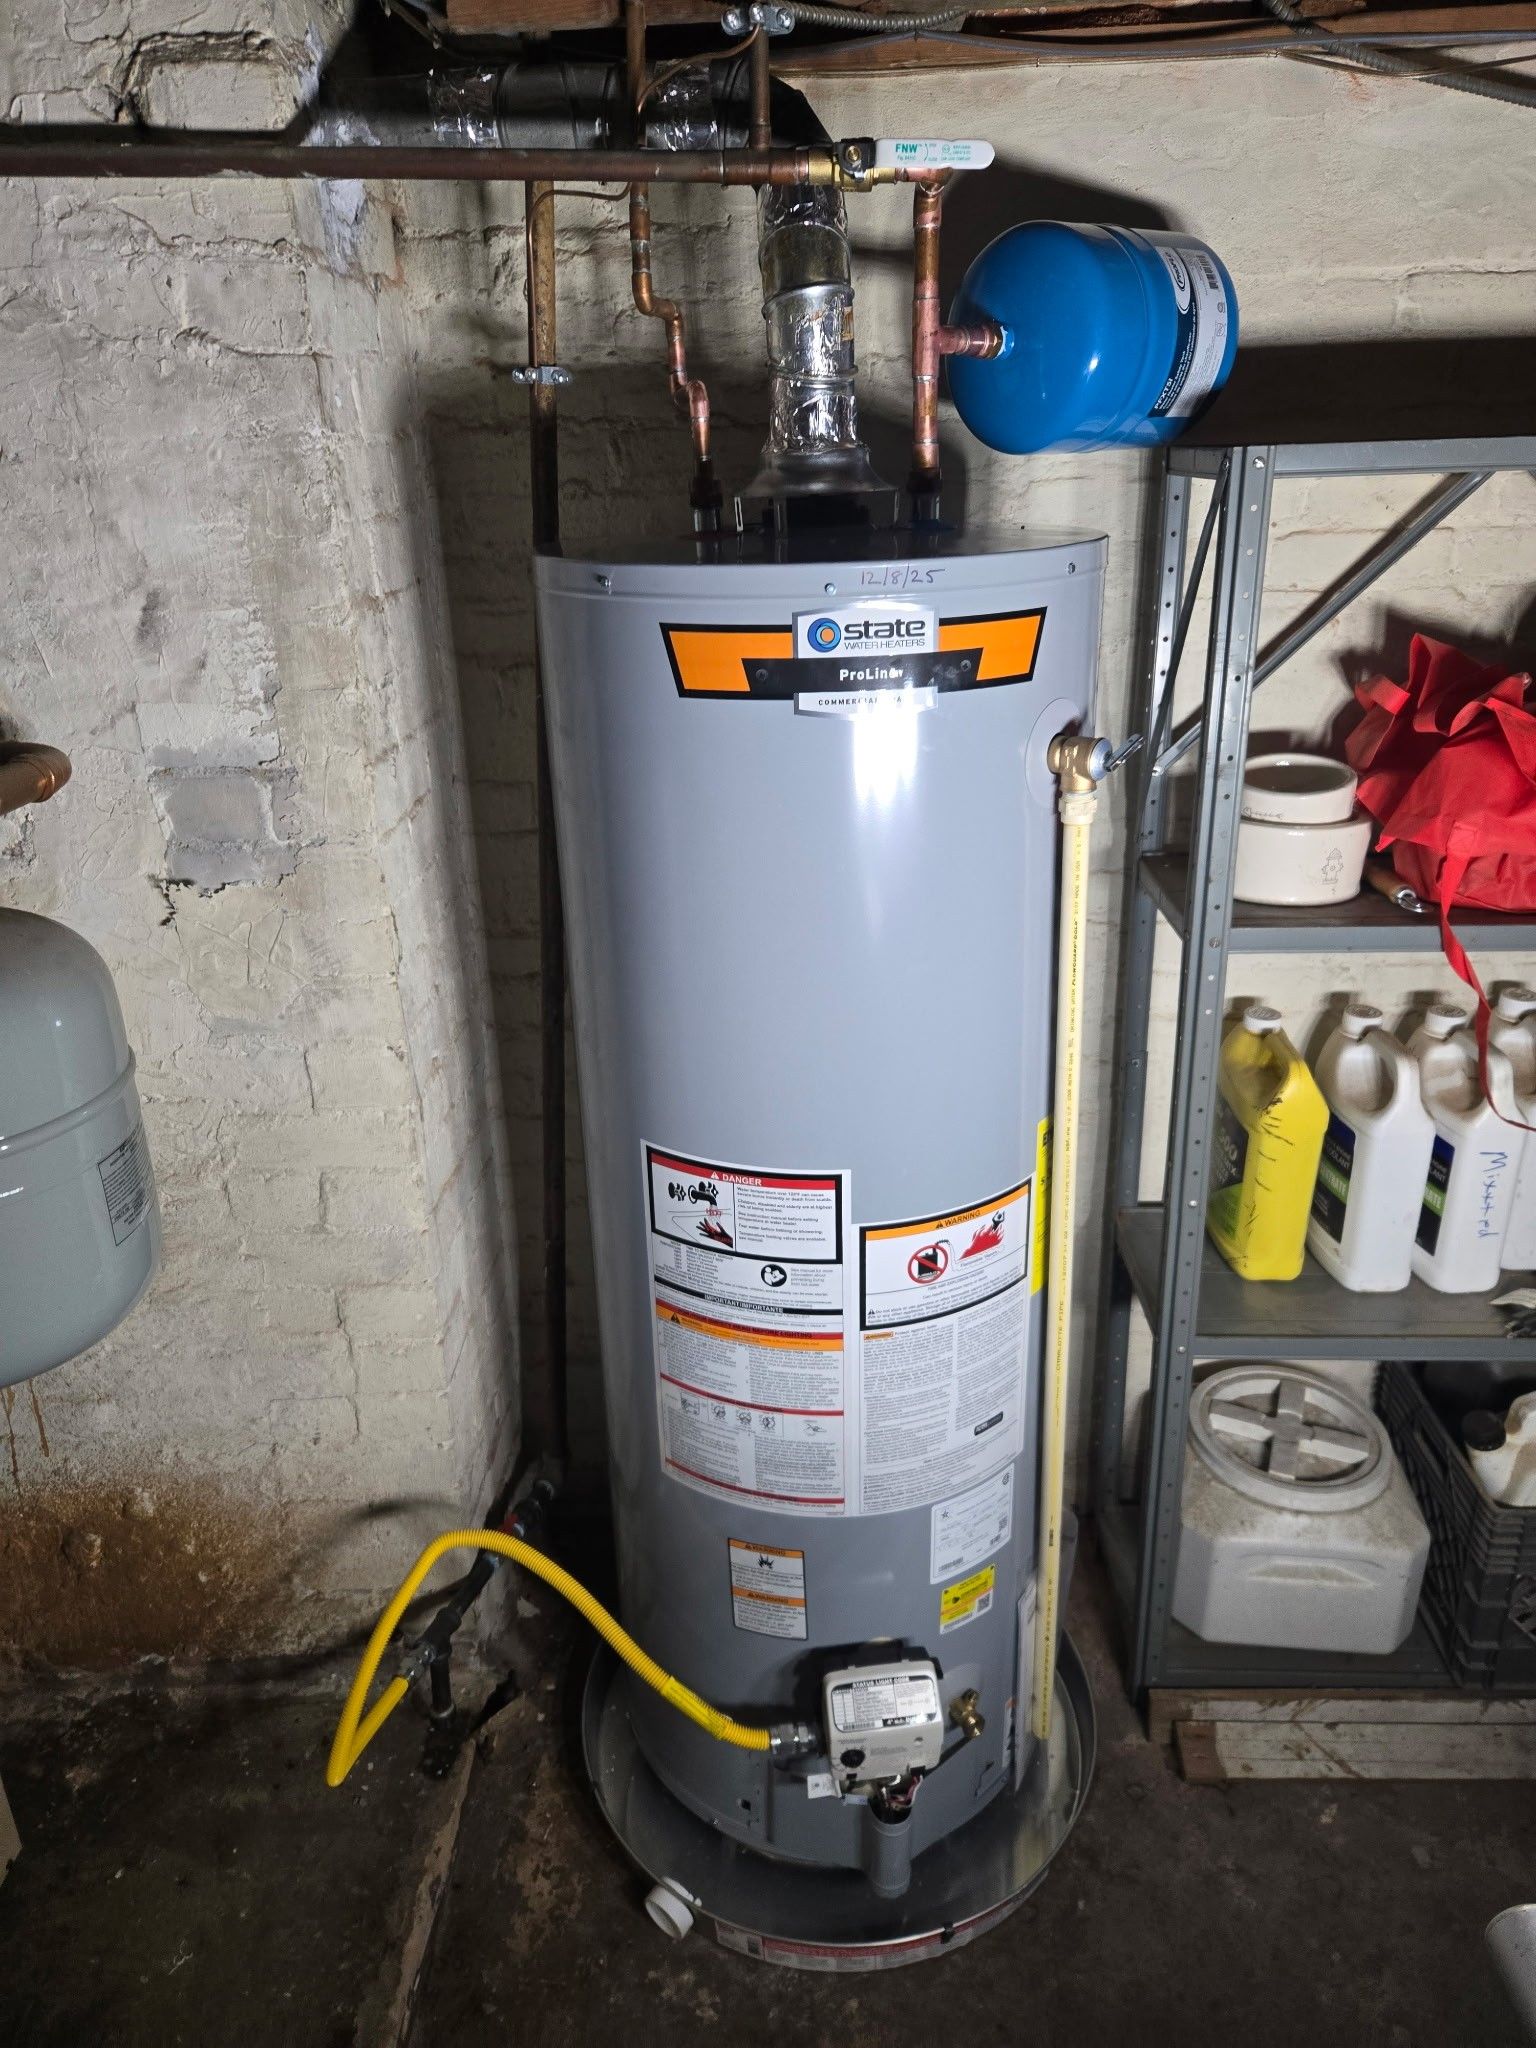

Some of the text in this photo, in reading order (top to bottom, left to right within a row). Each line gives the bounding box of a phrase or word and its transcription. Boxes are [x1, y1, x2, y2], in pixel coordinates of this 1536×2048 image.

[896, 144, 918, 152] FNW
[861, 563, 946, 589] 12/8/25
[844, 619, 926, 641] state
[844, 638, 925, 650] WATER HEATERS
[722, 1173, 762, 1187] DANGER
[944, 1210, 981, 1227] WARNING
